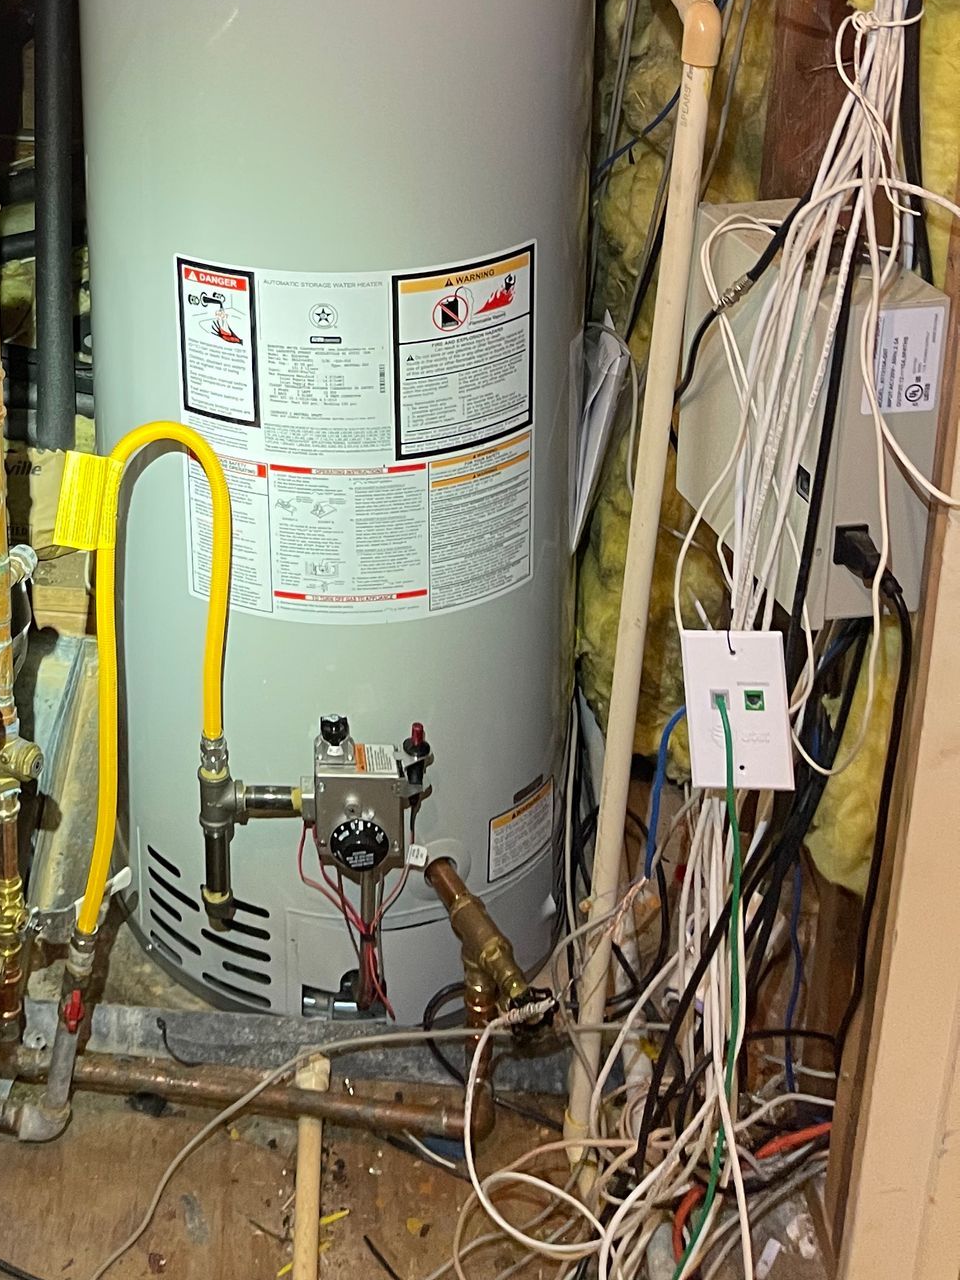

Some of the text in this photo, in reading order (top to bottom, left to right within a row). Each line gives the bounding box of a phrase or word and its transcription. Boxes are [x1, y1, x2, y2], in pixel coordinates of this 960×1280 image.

[200, 273, 237, 288] DANGER
[264, 279, 299, 287] AUTOMATIC
[456, 269, 495, 285] WARNING
